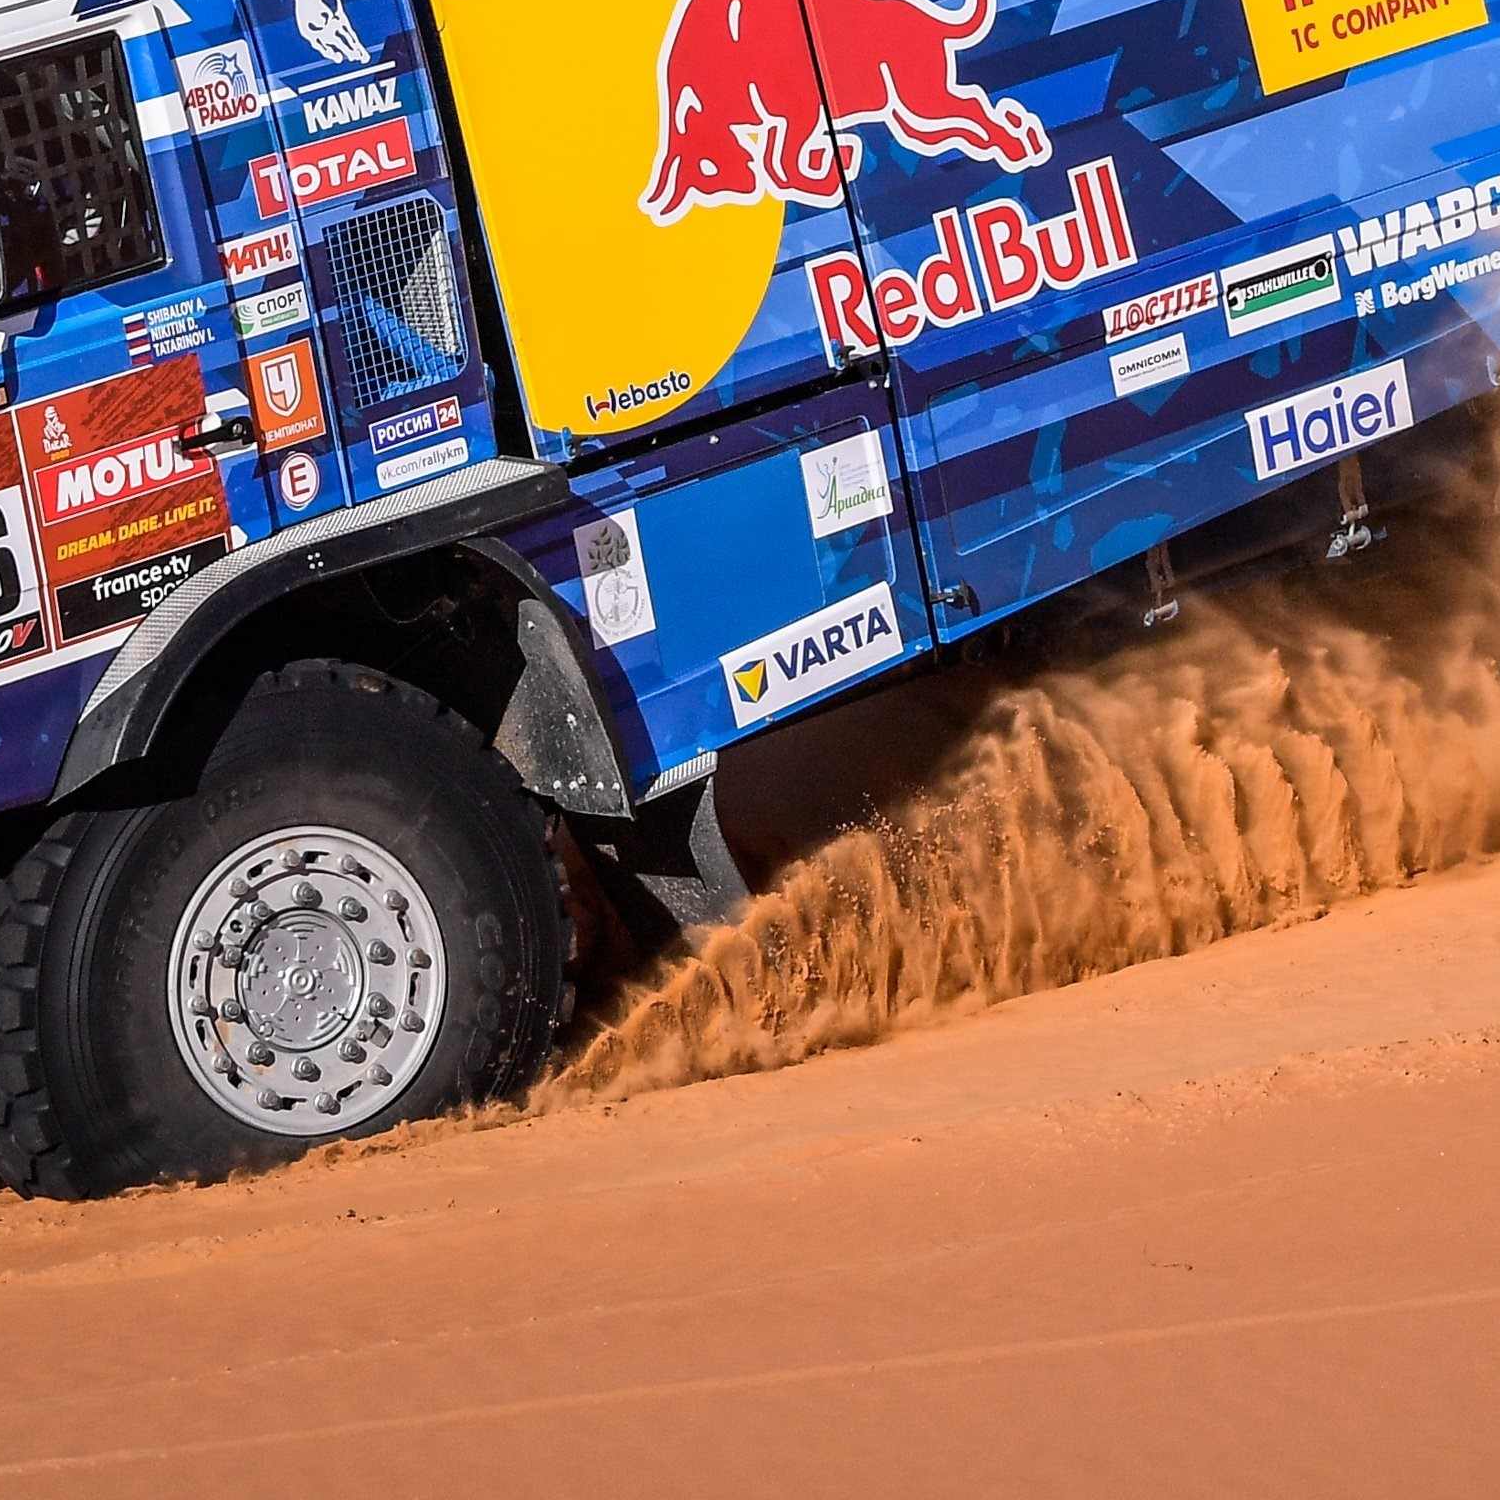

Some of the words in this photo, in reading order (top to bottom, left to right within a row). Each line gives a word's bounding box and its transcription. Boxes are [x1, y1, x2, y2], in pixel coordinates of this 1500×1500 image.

[184, 80, 229, 110] АВТО
[199, 93, 257, 127] РАДИО
[302, 77, 403, 134] KAMAZ
[259, 141, 407, 203] TOTAL
[219, 232, 292, 277] МАТЧ!
[257, 289, 302, 315] СПОРТ
[1246, 270, 1316, 301] STAHLWILLE
[147, 300, 196, 326] SHIBALOV
[195, 297, 208, 312] A.
[1109, 278, 1215, 338] LOCTITE
[150, 322, 188, 341] NIKITIN
[187, 319, 198, 332] D.
[153, 332, 206, 357] TATARINOV
[1118, 347, 1181, 376] OMNICOMM
[586, 369, 692, 422] Webasto
[377, 412, 433, 445] РОССИЯ
[438, 404, 457, 424] 24
[1260, 382, 1398, 470] Haier
[288, 461, 310, 498] E
[380, 444, 465, 481] vk.com/rallykm
[817, 475, 886, 519] Ариадна
[57, 529, 117, 562] DREAM.
[118, 514, 163, 541] DARE.
[165, 503, 197, 526] LIVE
[199, 496, 217, 513] IT.
[140, 573, 189, 608] spo
[773, 605, 892, 681] VARTA
